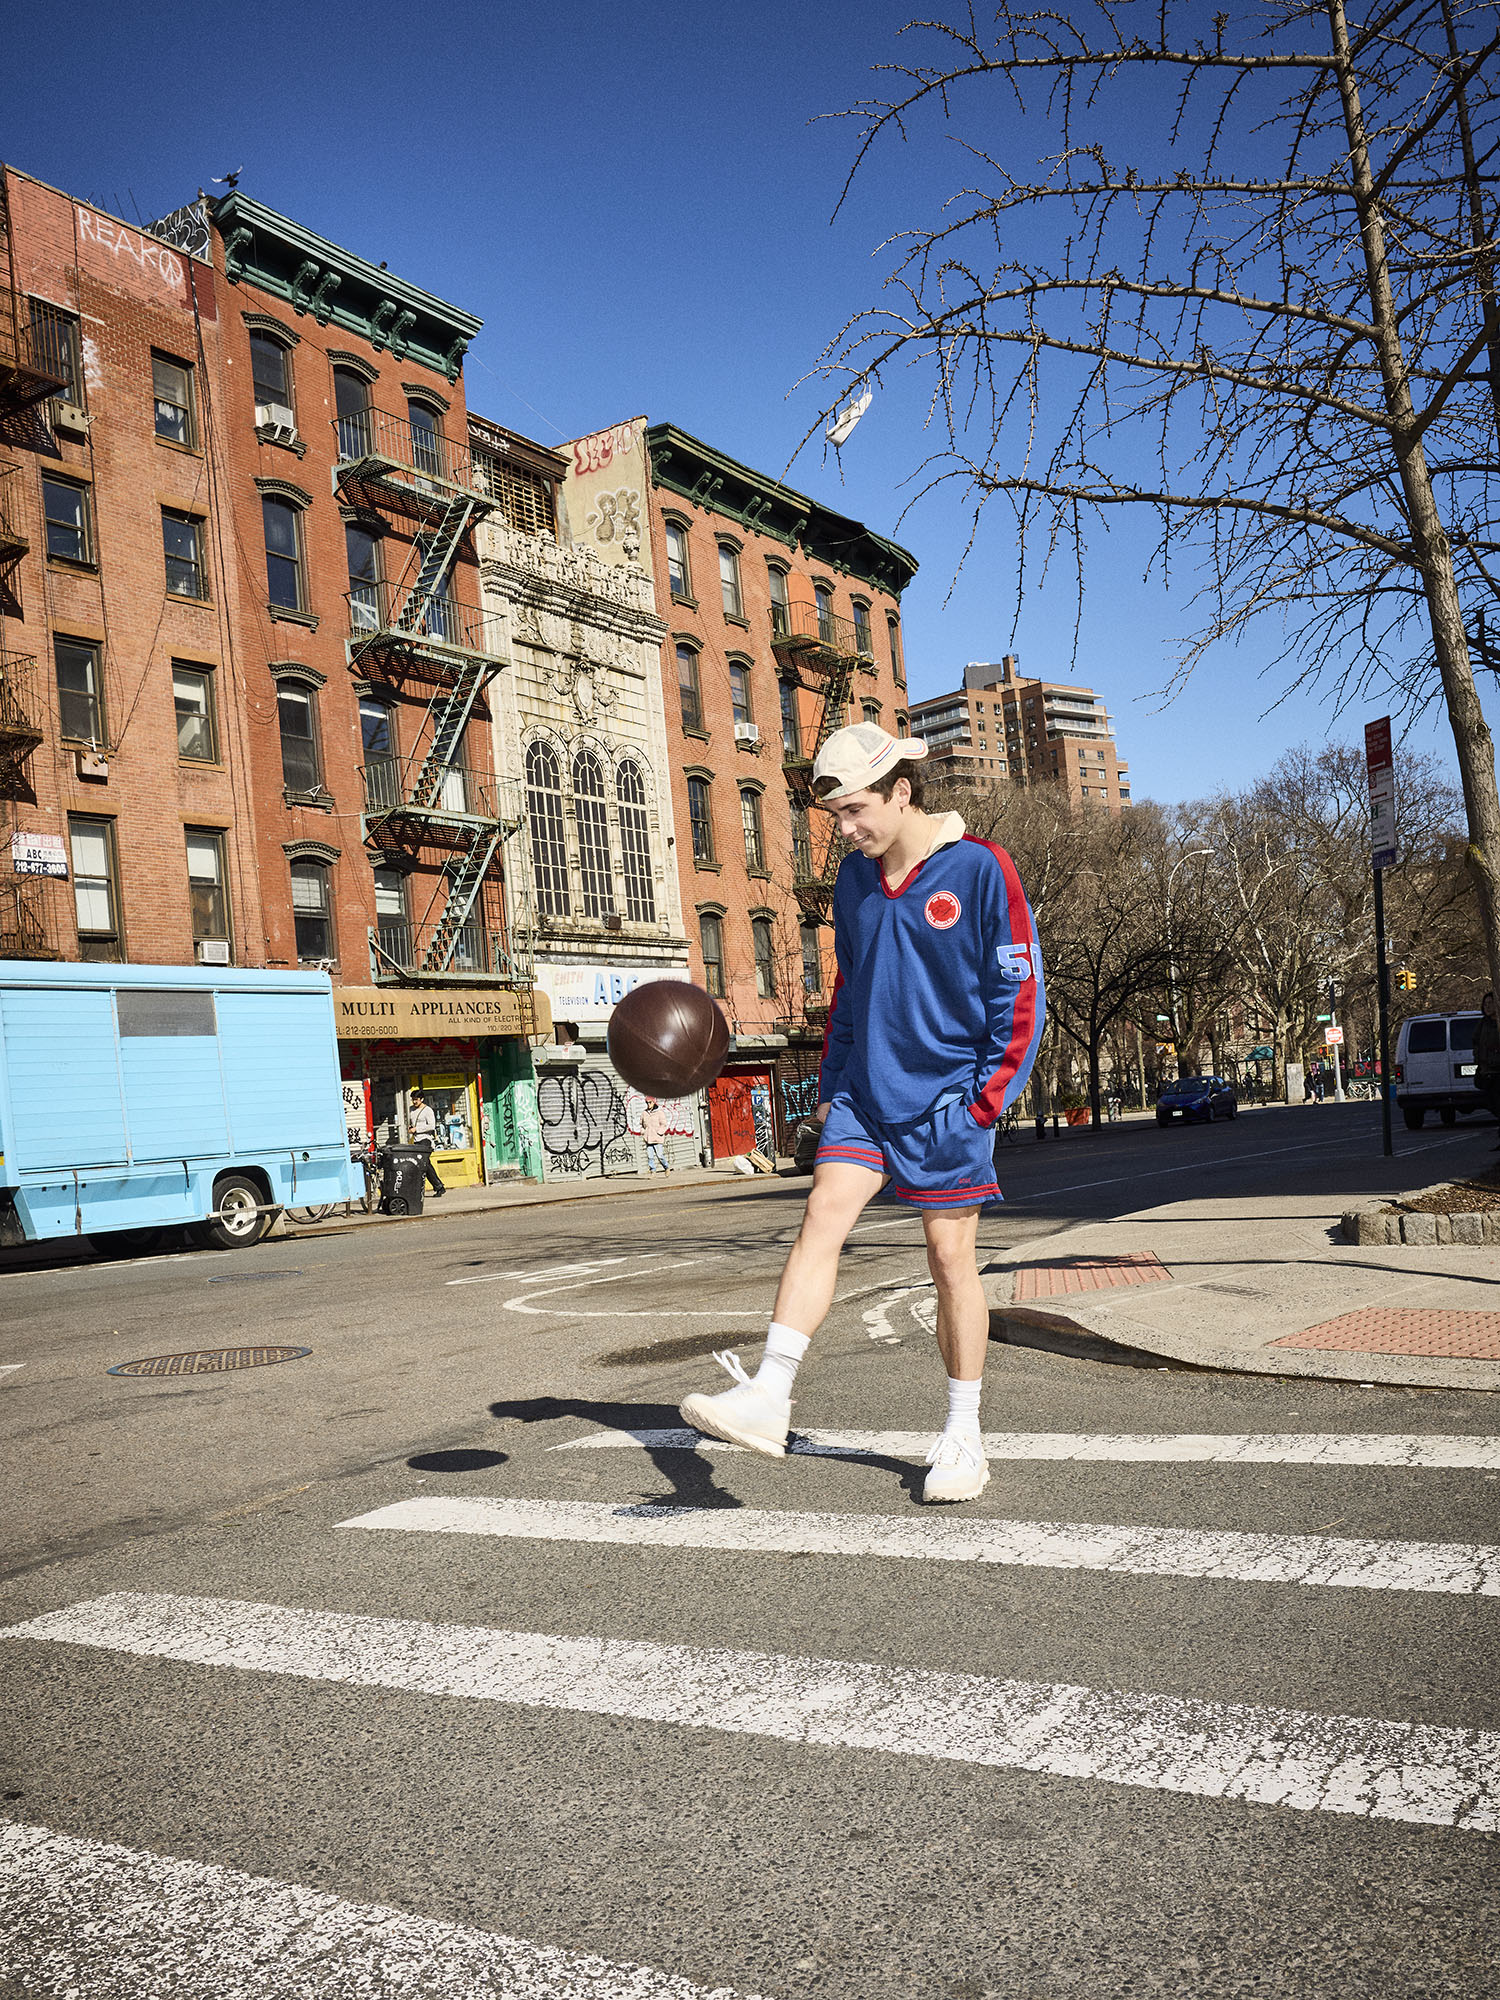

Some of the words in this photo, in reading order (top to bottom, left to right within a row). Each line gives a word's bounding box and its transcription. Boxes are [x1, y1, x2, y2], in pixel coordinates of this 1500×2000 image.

[26, 848, 42, 860] ABC
[559, 996, 589, 1006] TELEVISION
[341, 1001, 396, 1016] MULTI
[409, 1001, 502, 1015] APPLIANCES
[464, 1016, 481, 1024] KIND
[494, 1014, 540, 1023] ELECTRNICS
